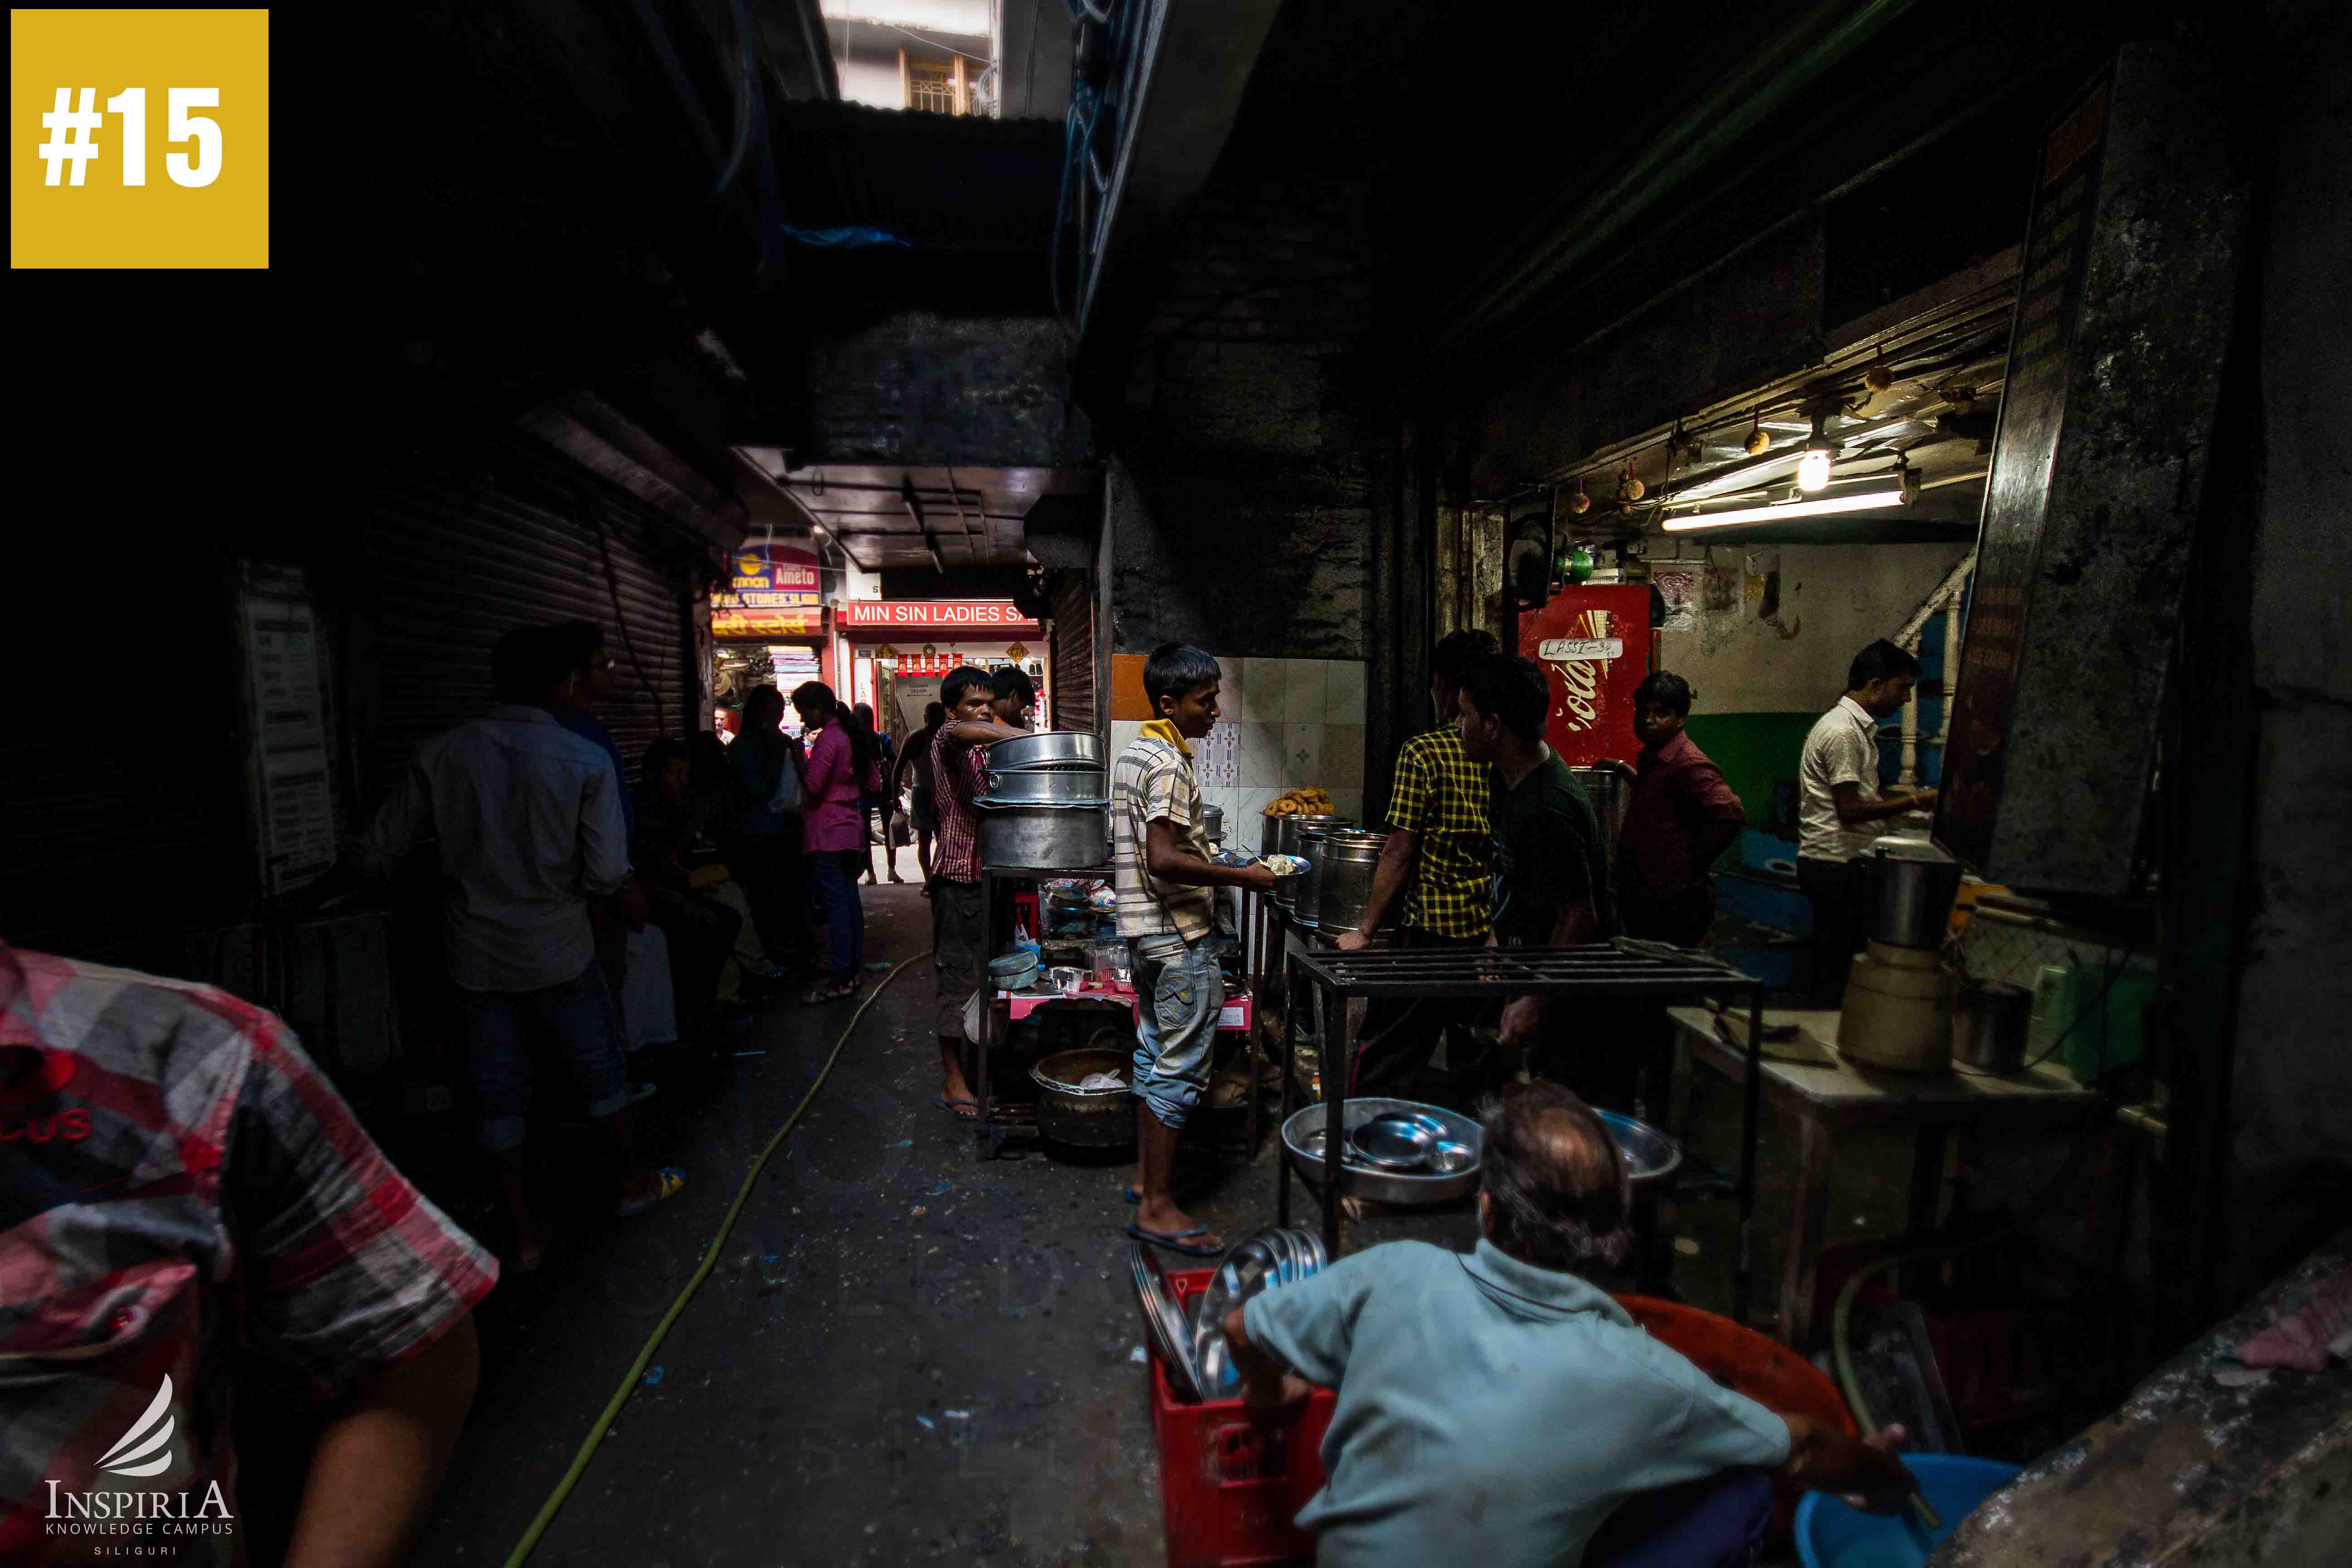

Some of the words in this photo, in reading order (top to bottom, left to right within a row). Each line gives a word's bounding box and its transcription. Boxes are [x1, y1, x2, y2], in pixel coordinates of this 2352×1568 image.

[775, 568, 815, 585] Ameto
[854, 606, 889, 621] MIN
[895, 606, 927, 621] SIN
[933, 606, 1000, 621] LADIES
